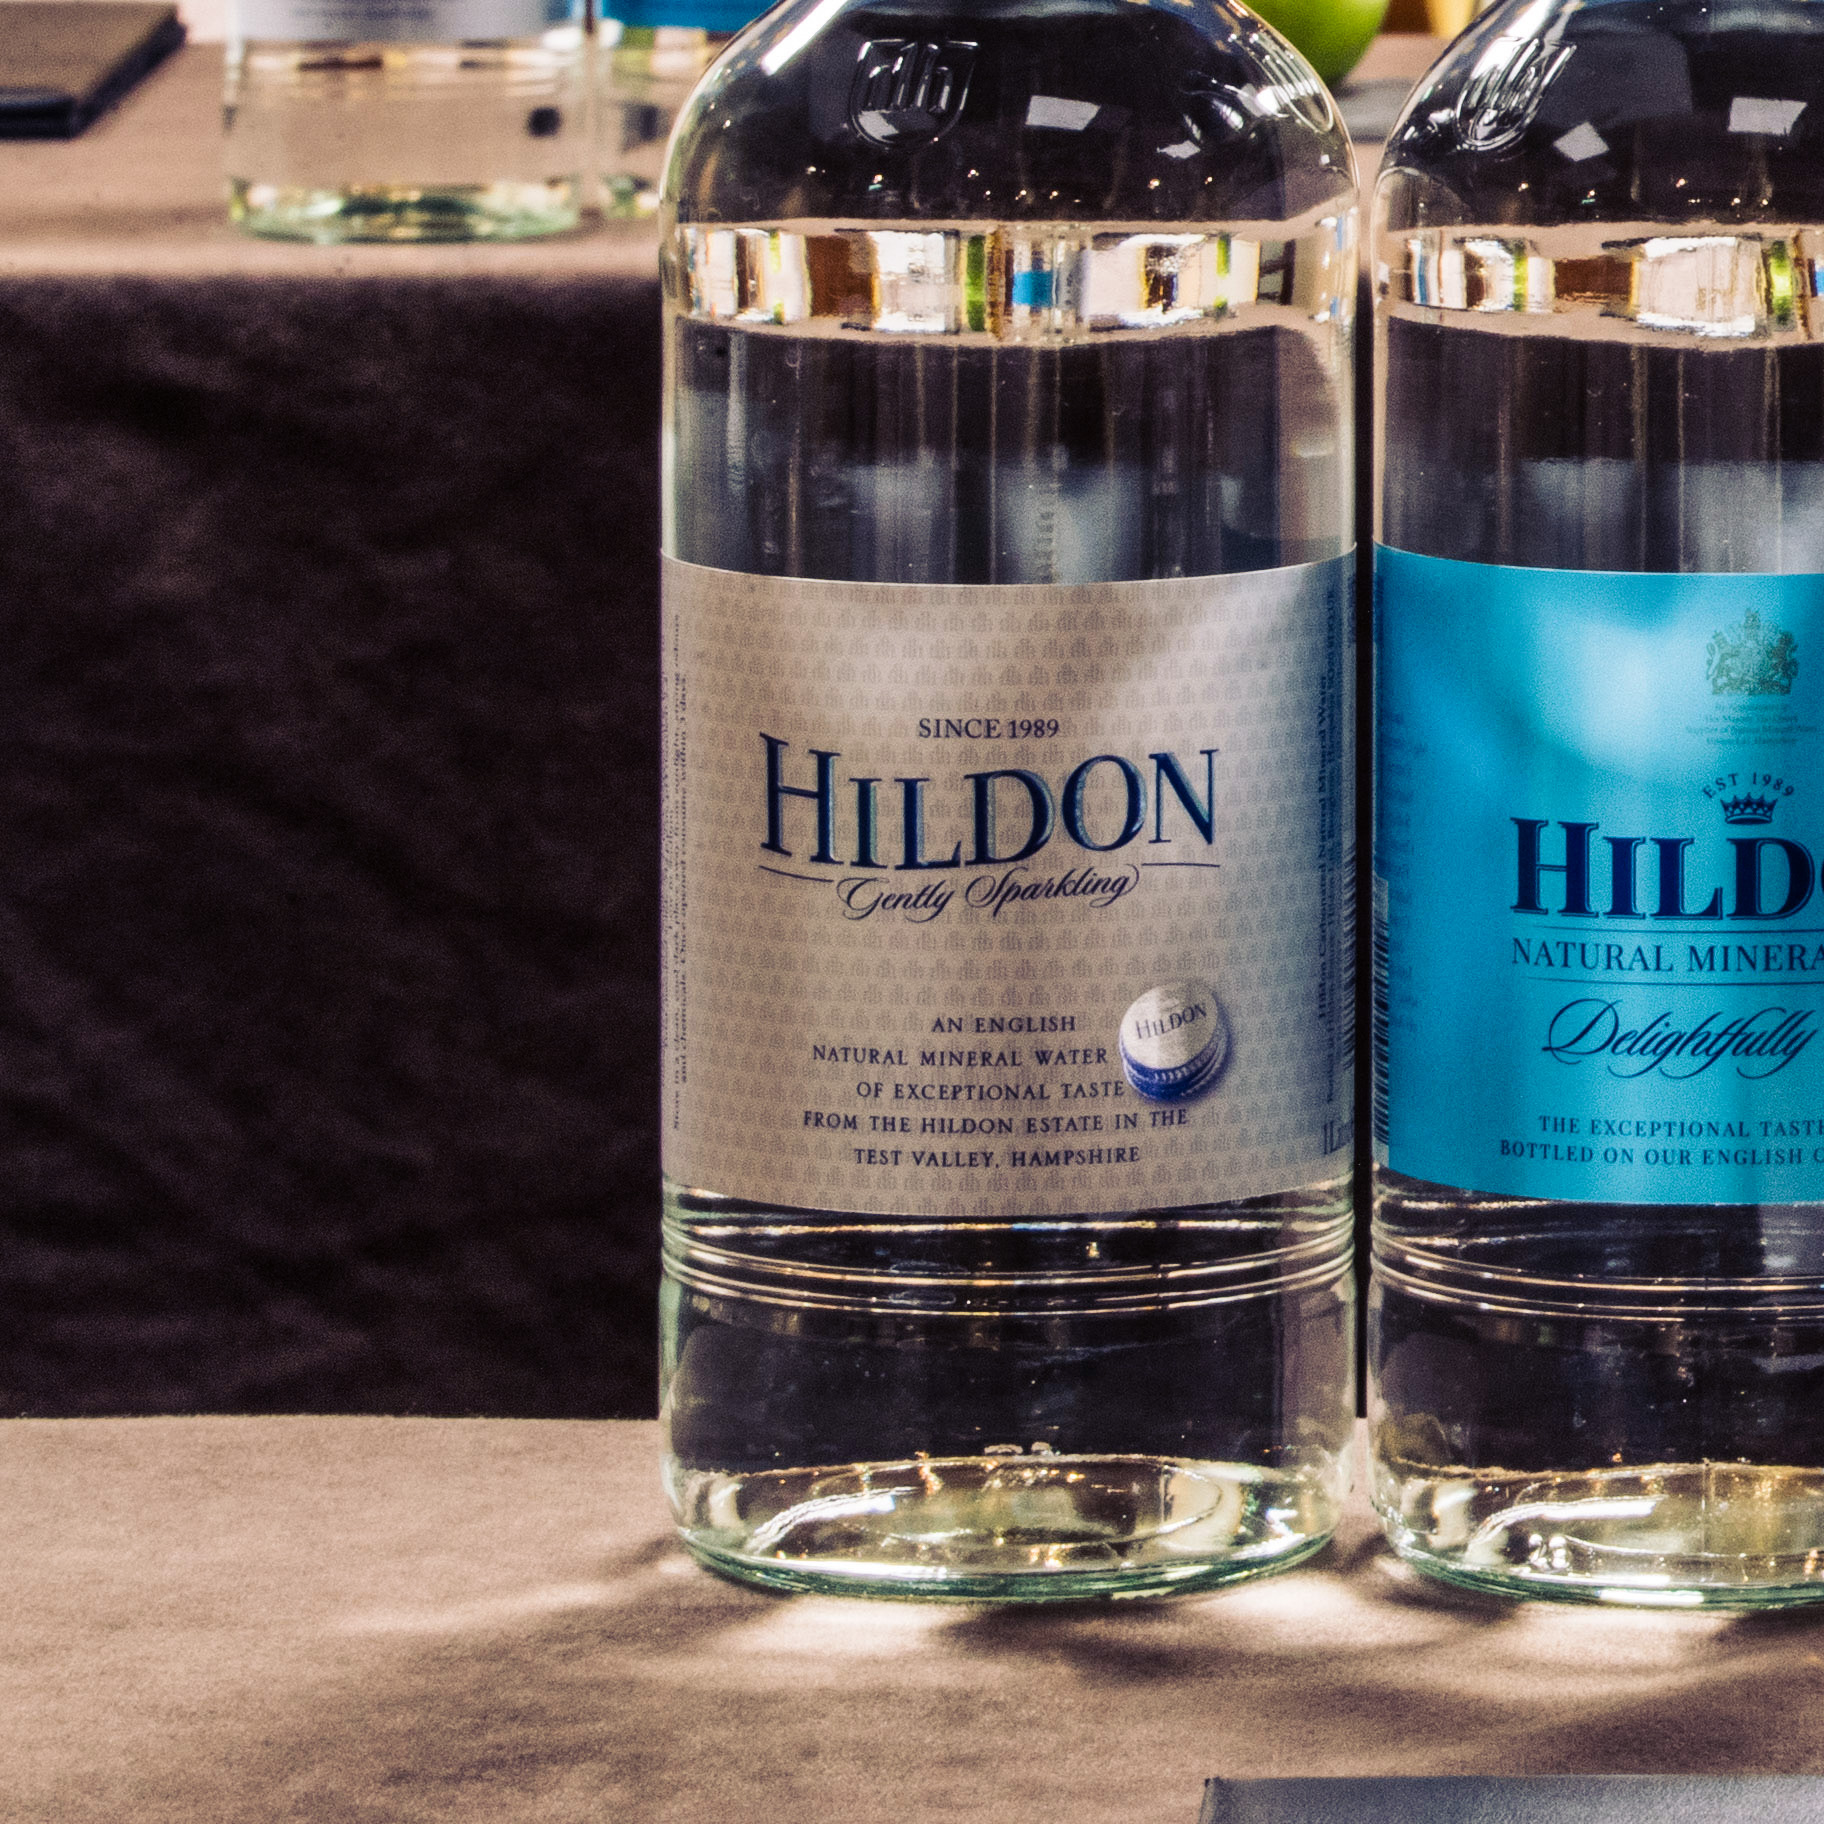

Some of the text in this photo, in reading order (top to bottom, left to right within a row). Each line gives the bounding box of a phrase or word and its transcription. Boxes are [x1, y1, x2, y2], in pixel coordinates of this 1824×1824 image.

[918, 718, 1060, 738] SINCE 1989
[1702, 772, 1795, 799] EST 1989
[758, 732, 1220, 871] HILDON
[836, 864, 1143, 923] Gently Sparkling
[1511, 937, 1673, 973] NATURAL
[931, 1016, 1076, 1033] AN ENGLISH
[1135, 1003, 1208, 1040] HILDON
[1542, 998, 1819, 1080] Delightfully
[812, 1044, 1108, 1066] NATURAL MINERAL WATER
[856, 1081, 1125, 1100] OF EXCEPTIONAL TASTE
[803, 1109, 1188, 1134] FROM THE HILDON ESTATE IN THE
[1538, 1115, 1581, 1134] THE
[1591, 1119, 1750, 1137] EXCEPTIONAL
[854, 1148, 903, 1166] TEST
[1011, 1146, 1141, 1167] HAMPSHIRE
[1500, 1139, 1593, 1162] BOTTLED
[1603, 1147, 1634, 1164] ON
[1645, 1149, 1691, 1165] OUR
[1703, 1148, 1802, 1165] ENGLISH
